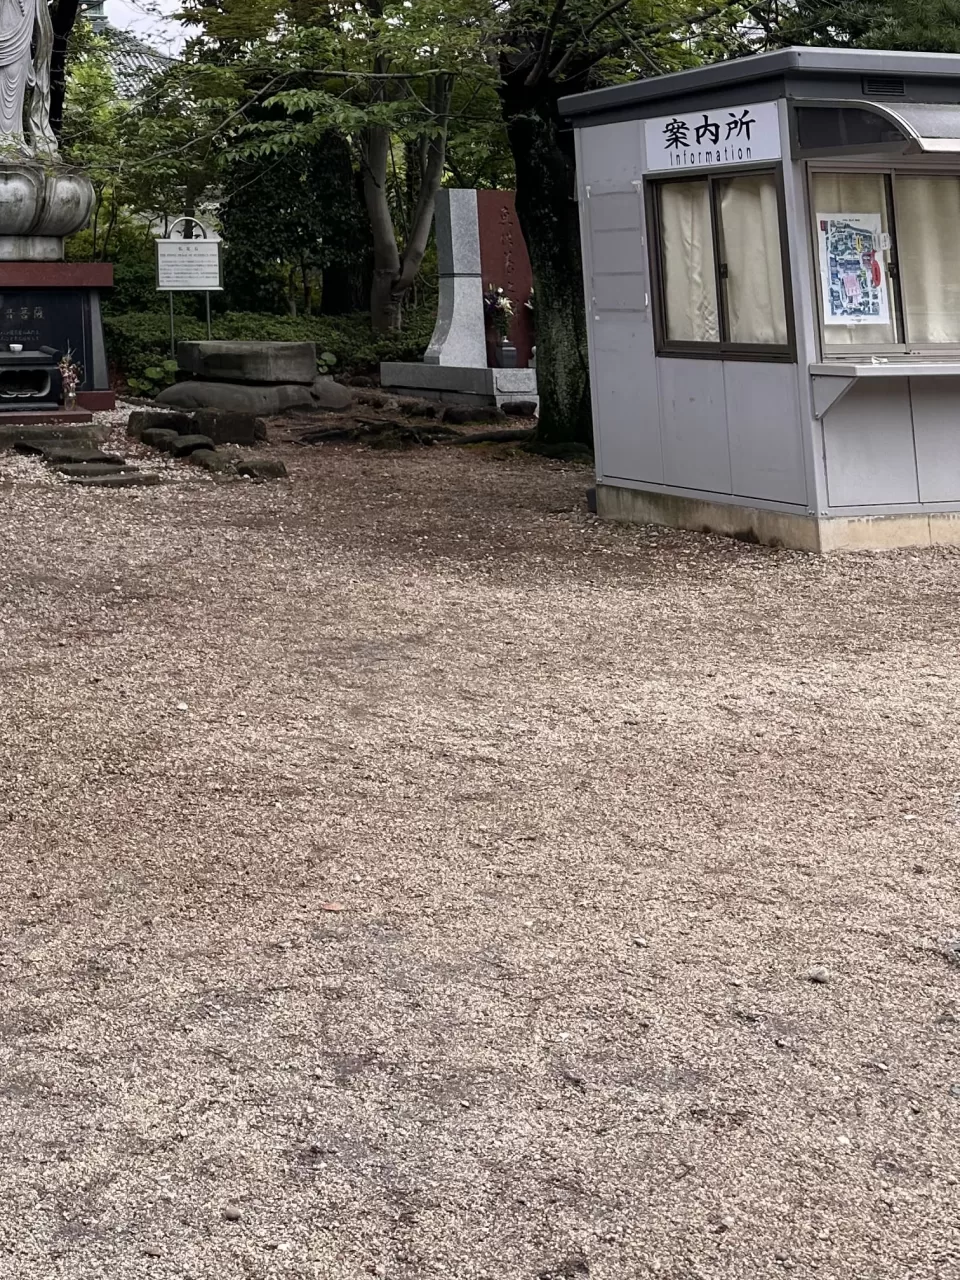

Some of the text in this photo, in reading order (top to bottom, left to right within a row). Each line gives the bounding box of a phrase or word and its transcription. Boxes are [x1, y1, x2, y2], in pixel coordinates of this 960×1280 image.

[662, 109, 756, 149] 案内所
[669, 145, 752, 166] Information
